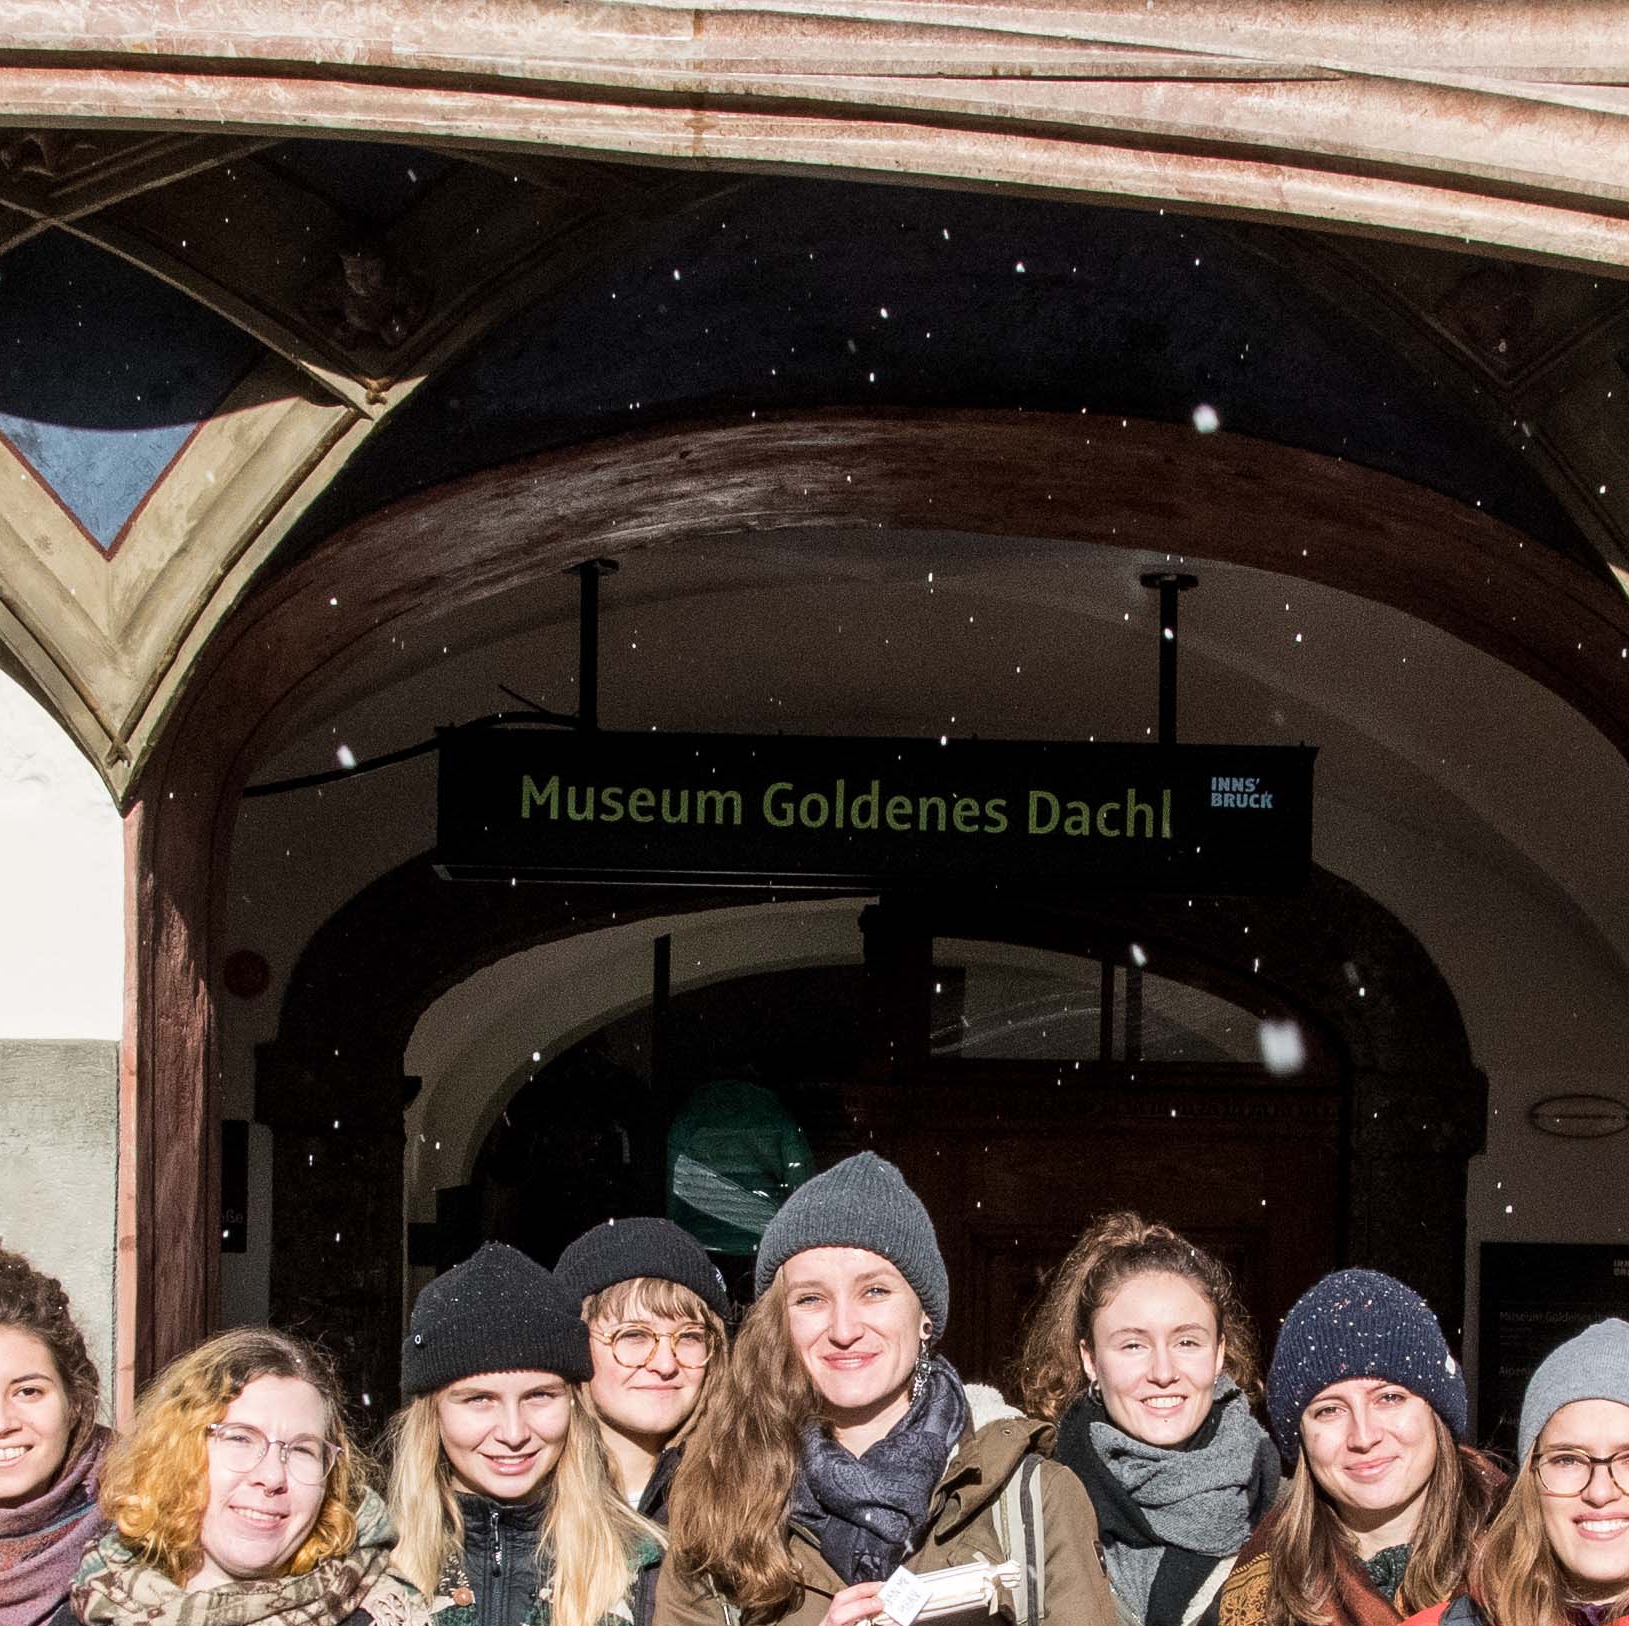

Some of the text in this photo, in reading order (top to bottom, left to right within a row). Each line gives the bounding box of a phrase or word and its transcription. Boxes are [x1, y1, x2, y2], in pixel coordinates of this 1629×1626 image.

[522, 774, 1171, 839] Museum Goldenes Dachl
[1210, 793, 1273, 809] BRUCK
